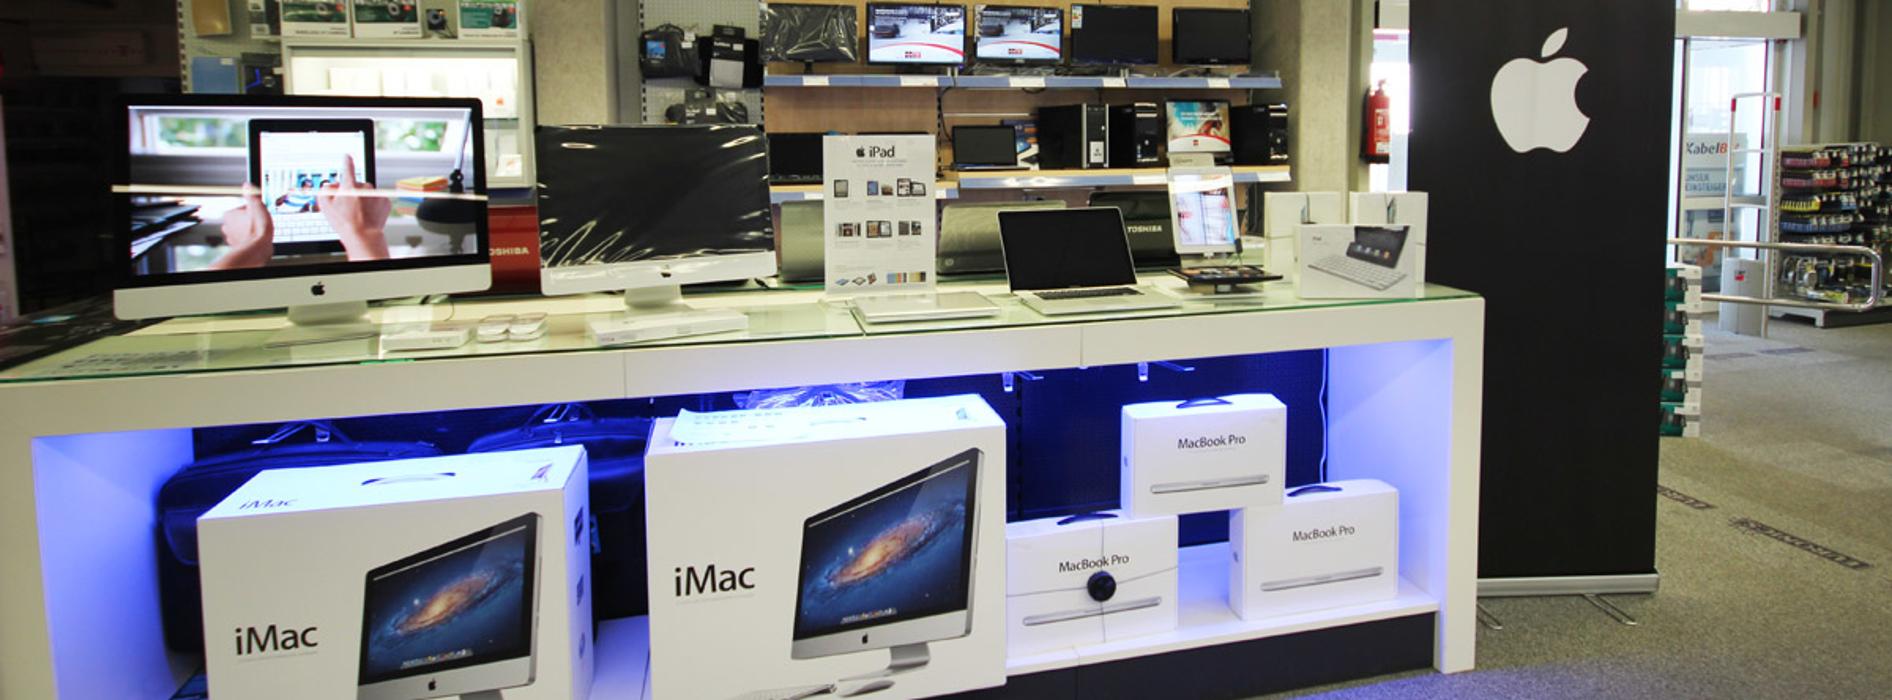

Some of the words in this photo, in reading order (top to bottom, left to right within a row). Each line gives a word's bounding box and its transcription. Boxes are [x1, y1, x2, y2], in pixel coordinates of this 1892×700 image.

[868, 145, 896, 158] iPad
[1686, 142, 1740, 155] KabelB
[1127, 224, 1163, 233] TOSHIBA
[489, 246, 530, 256] OSHIBA
[1177, 434, 1226, 449] MacBook
[1228, 433, 1247, 445] Pro
[239, 498, 298, 510] iMac
[1291, 526, 1337, 541] MacBook
[1339, 524, 1356, 536] Pro
[1058, 556, 1110, 573] MacBook
[1111, 553, 1130, 565] Pro
[674, 563, 756, 597] iMac
[235, 623, 319, 656] iMac
